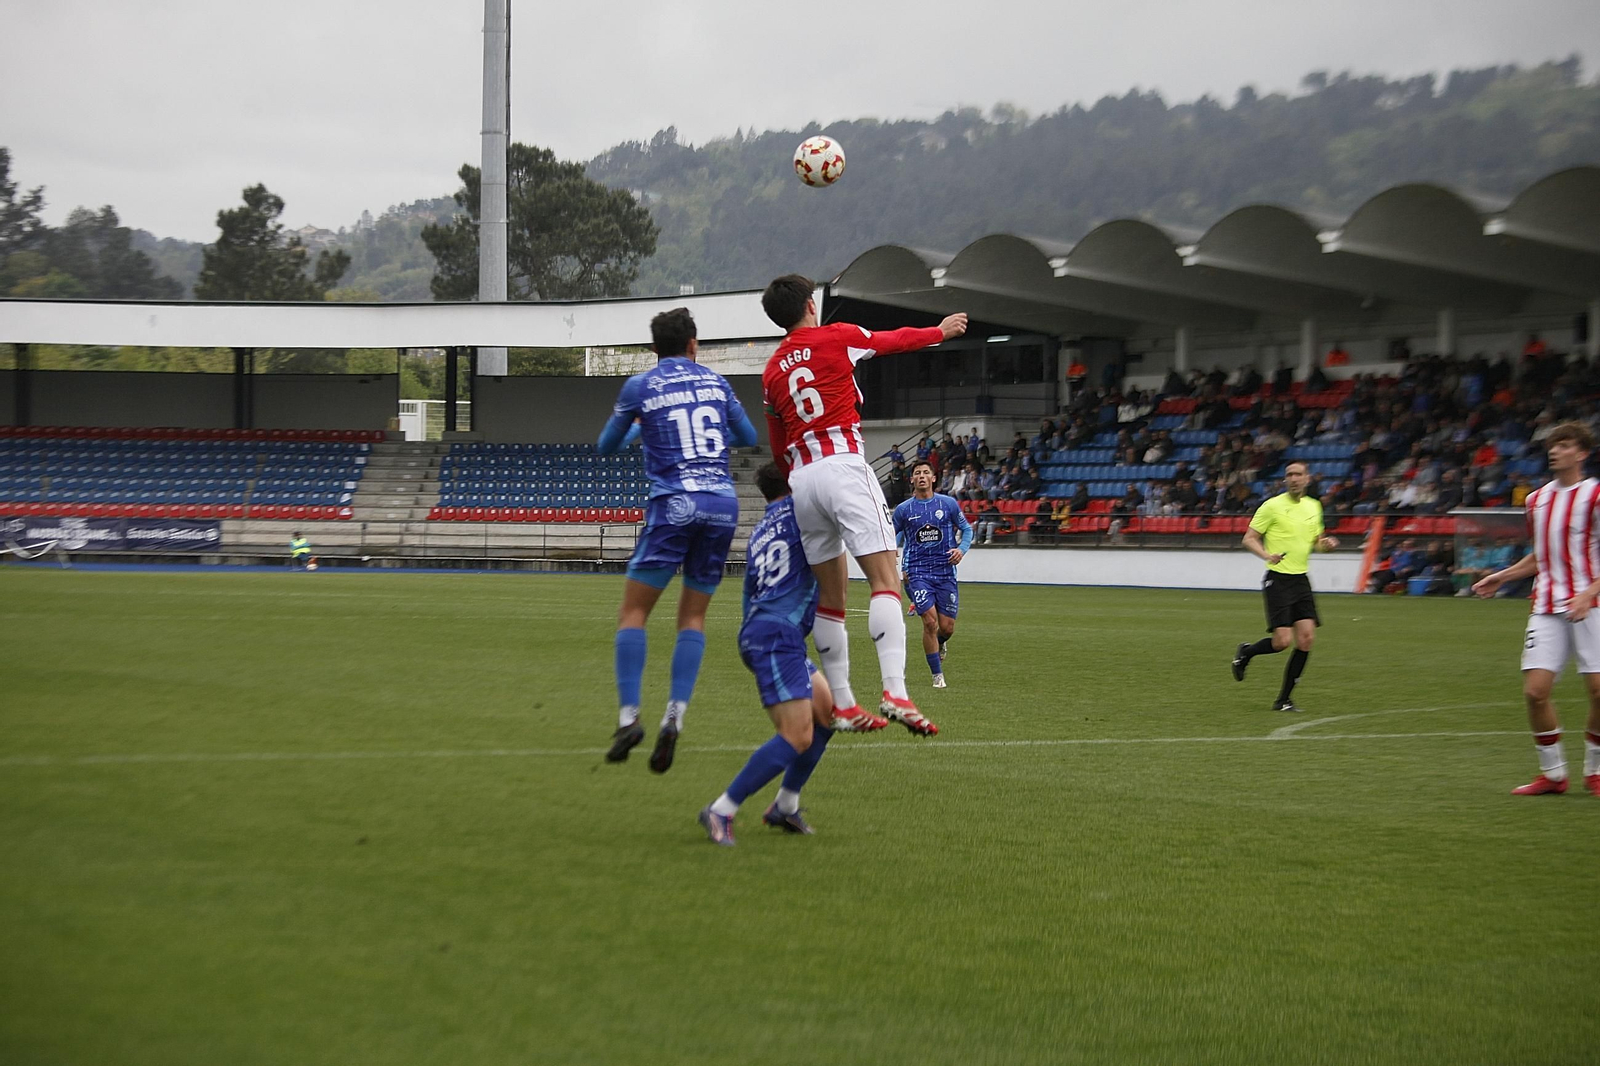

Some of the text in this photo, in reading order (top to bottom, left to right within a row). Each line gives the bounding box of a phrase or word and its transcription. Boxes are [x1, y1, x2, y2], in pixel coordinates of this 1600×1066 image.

[778, 347, 812, 372] REGO
[642, 390, 696, 413] JUANMA
[788, 366, 825, 424] 6
[667, 405, 726, 460] 16
[776, 522, 787, 535] F.
[919, 529, 939, 537] Estrella
[754, 540, 791, 590] 19
[914, 589, 928, 603] 22
